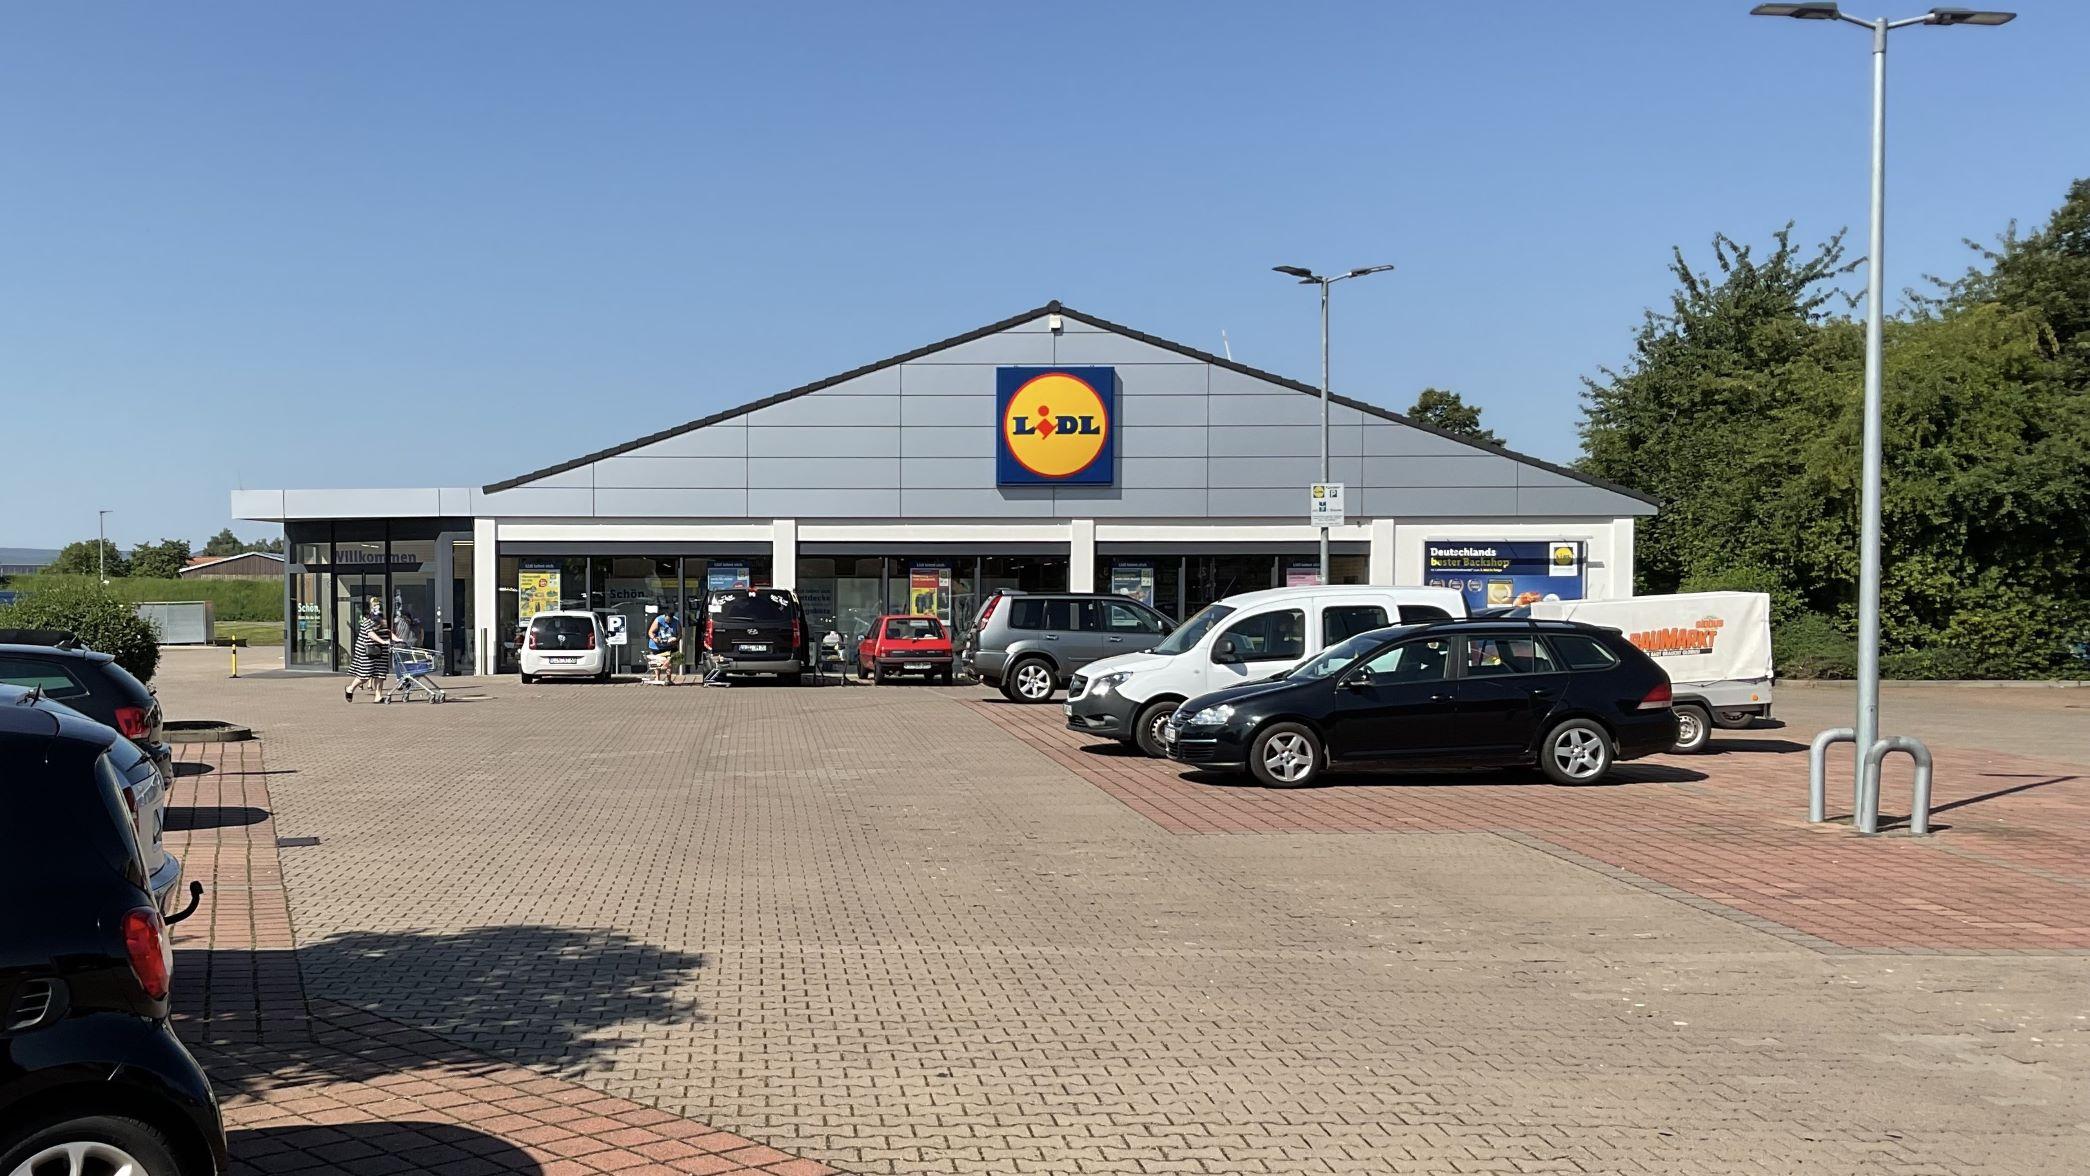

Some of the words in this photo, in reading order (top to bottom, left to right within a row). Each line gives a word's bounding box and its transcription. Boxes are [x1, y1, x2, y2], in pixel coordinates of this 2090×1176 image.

[1013, 405, 1100, 440] LIDL
[1430, 548, 1497, 557] Deutschlands
[1430, 557, 1461, 567] bester
